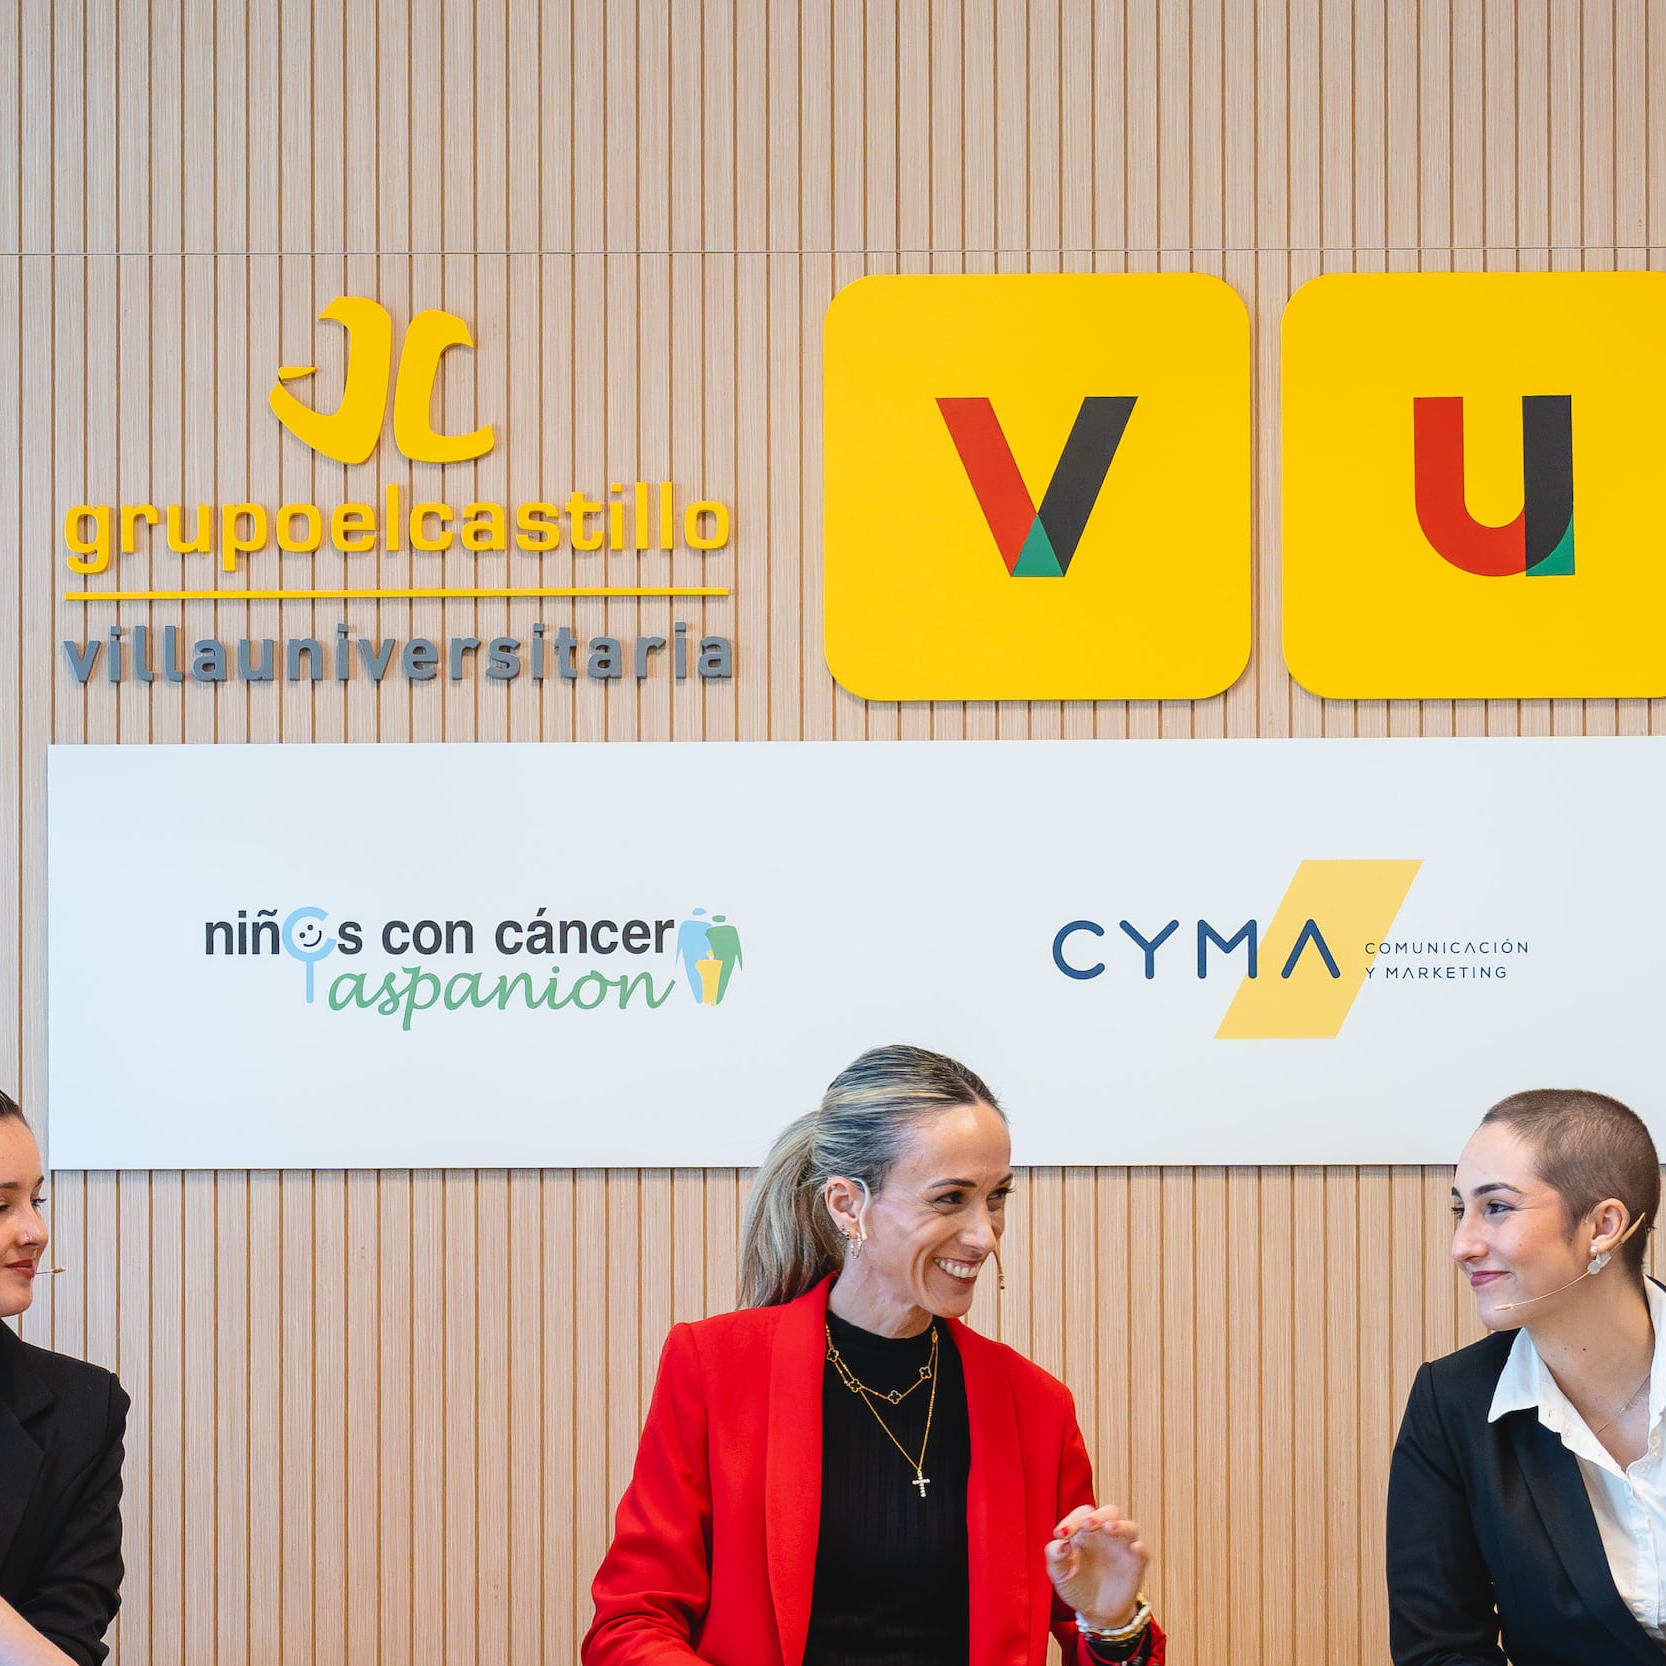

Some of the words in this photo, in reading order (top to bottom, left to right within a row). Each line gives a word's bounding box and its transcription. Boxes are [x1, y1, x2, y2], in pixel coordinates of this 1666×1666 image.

[64, 480, 732, 574] grupoelcastillo
[63, 622, 733, 685] villauniversitaria
[380, 918, 475, 956] con
[494, 906, 676, 956] cáncer
[1051, 917, 1342, 982] CYMA
[1363, 937, 1530, 956] COMUNICACIÓN
[327, 964, 677, 1032] aspanion
[1364, 966, 1376, 980] Y
[1385, 965, 1508, 980] MARKETING
